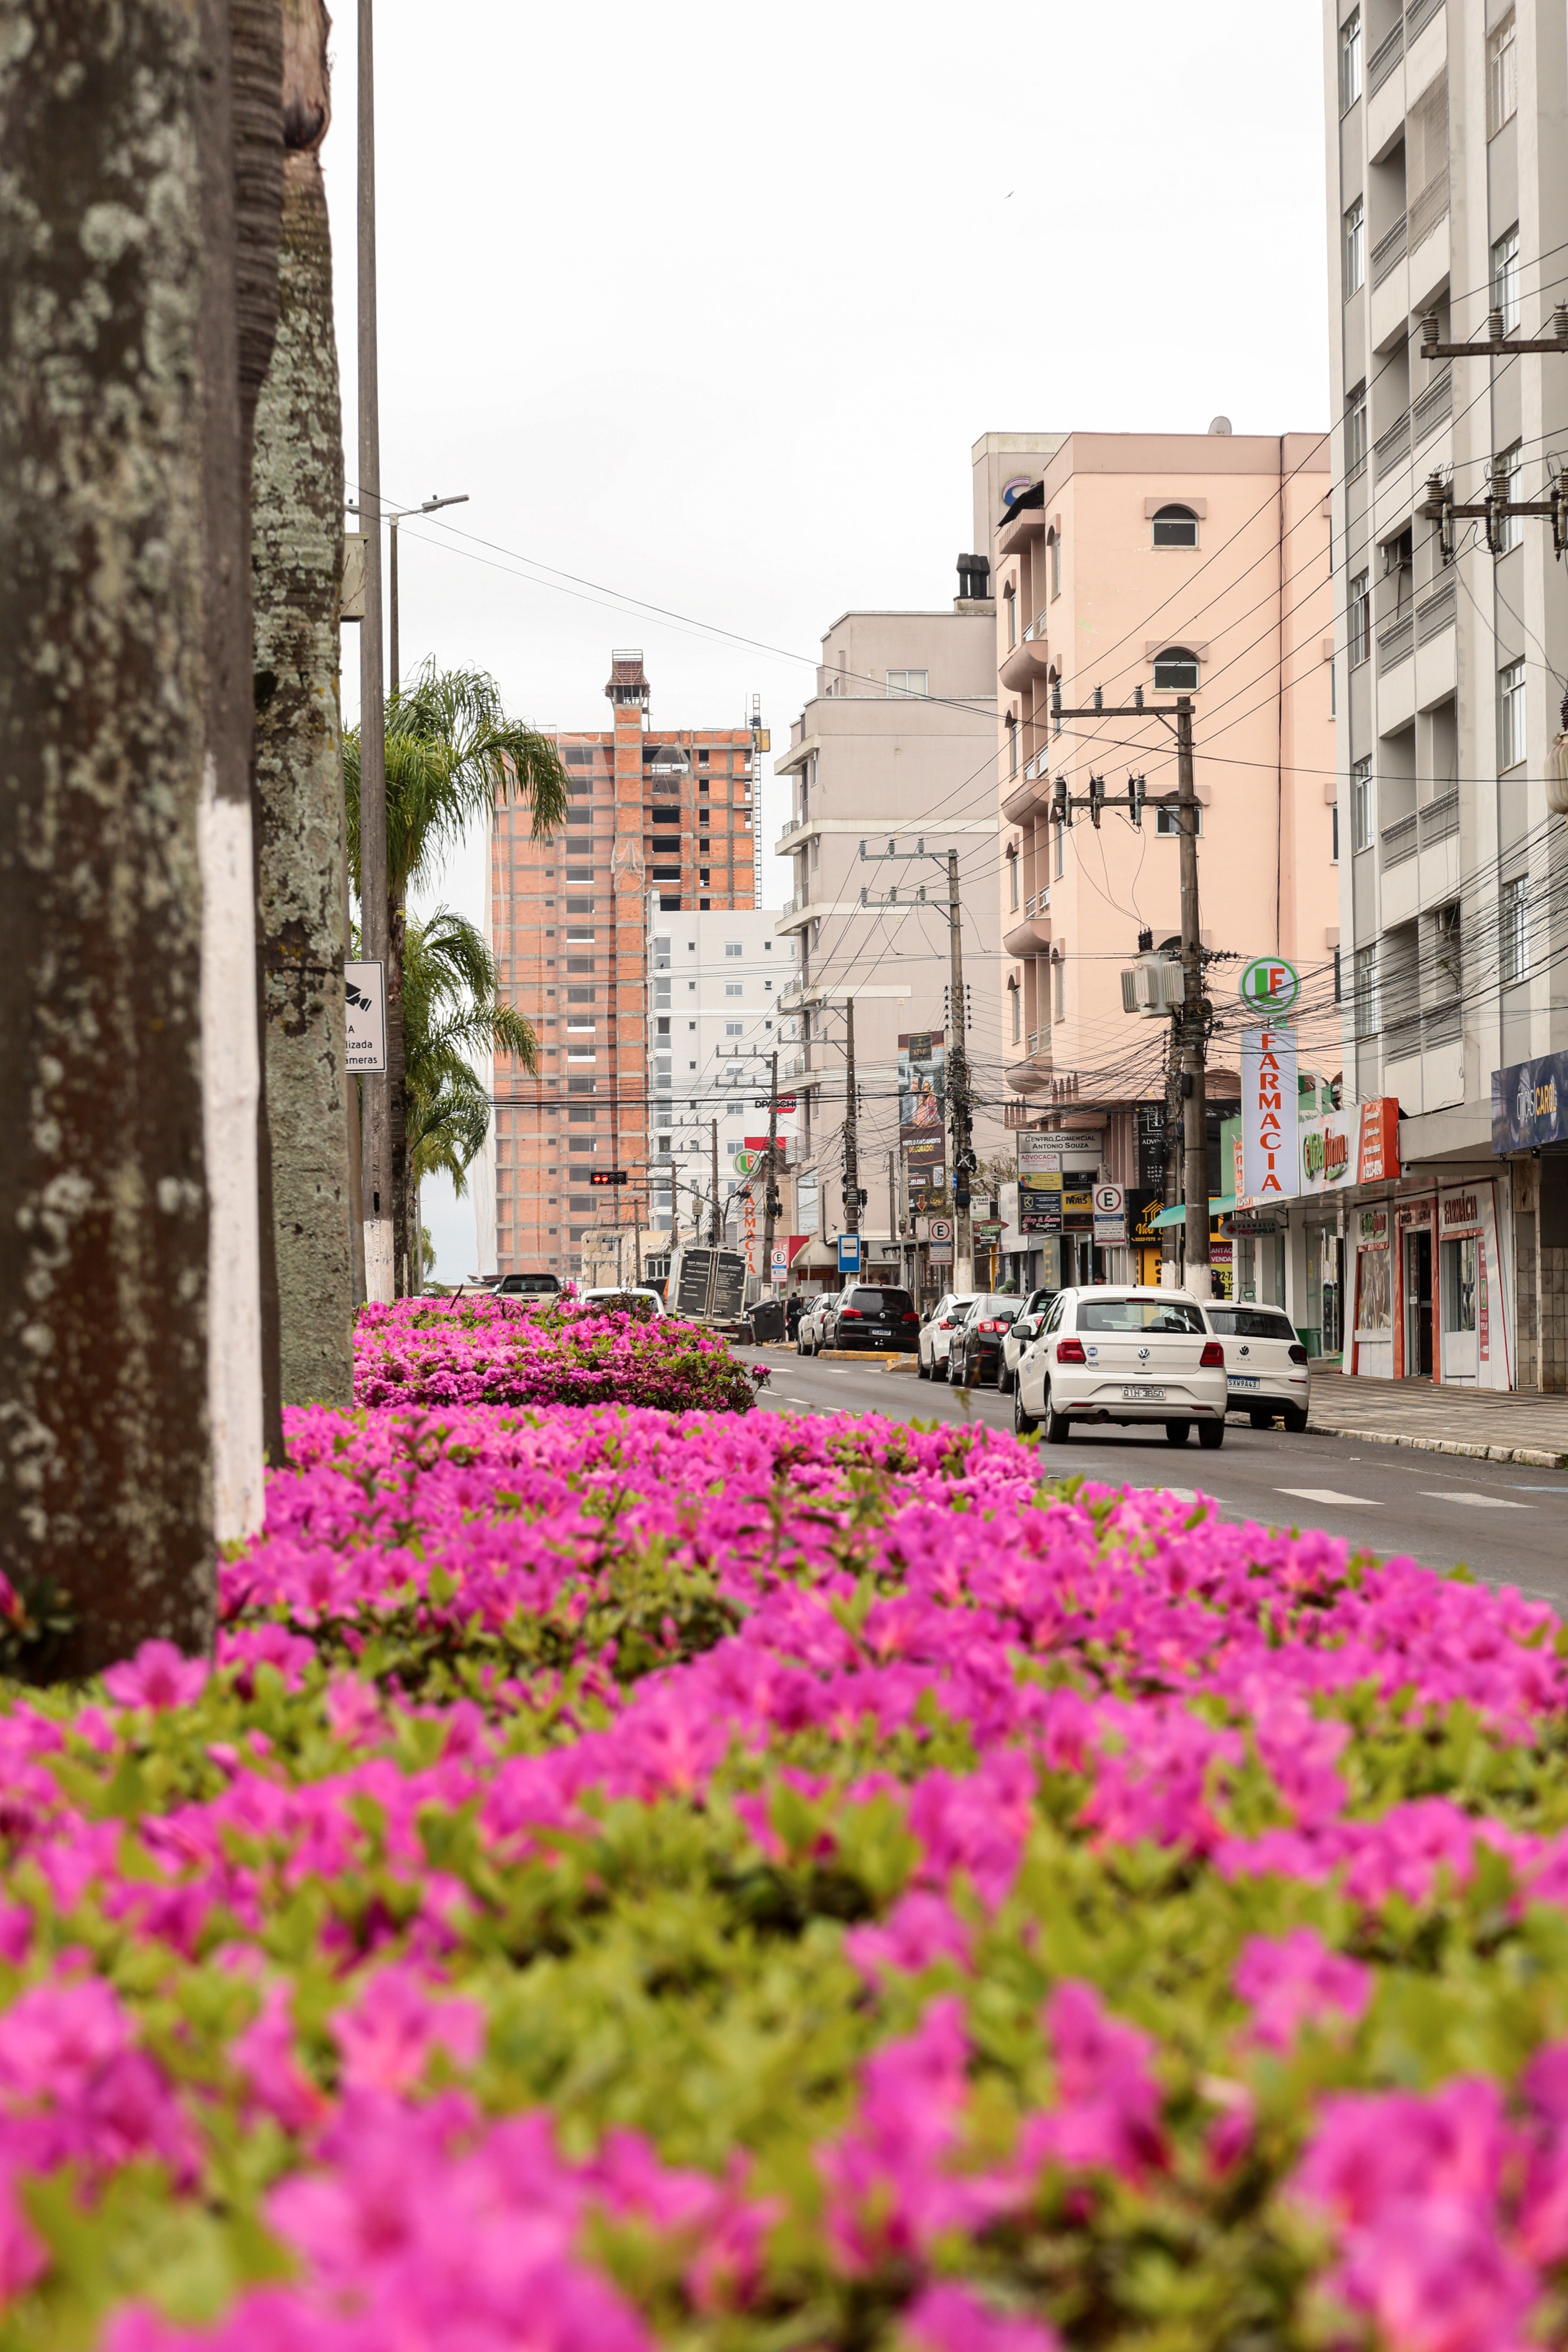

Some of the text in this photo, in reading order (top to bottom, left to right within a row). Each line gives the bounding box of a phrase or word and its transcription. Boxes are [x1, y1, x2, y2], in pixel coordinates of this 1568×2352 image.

[1536, 1083, 1557, 1116] CAROL
[1259, 1033, 1282, 1191] FARMÁCIA
[1104, 1192, 1114, 1207] E
[1444, 1190, 1477, 1224] FARMÁCIA
[937, 1225, 944, 1236] E
[1228, 1379, 1257, 1388] SXW9A43
